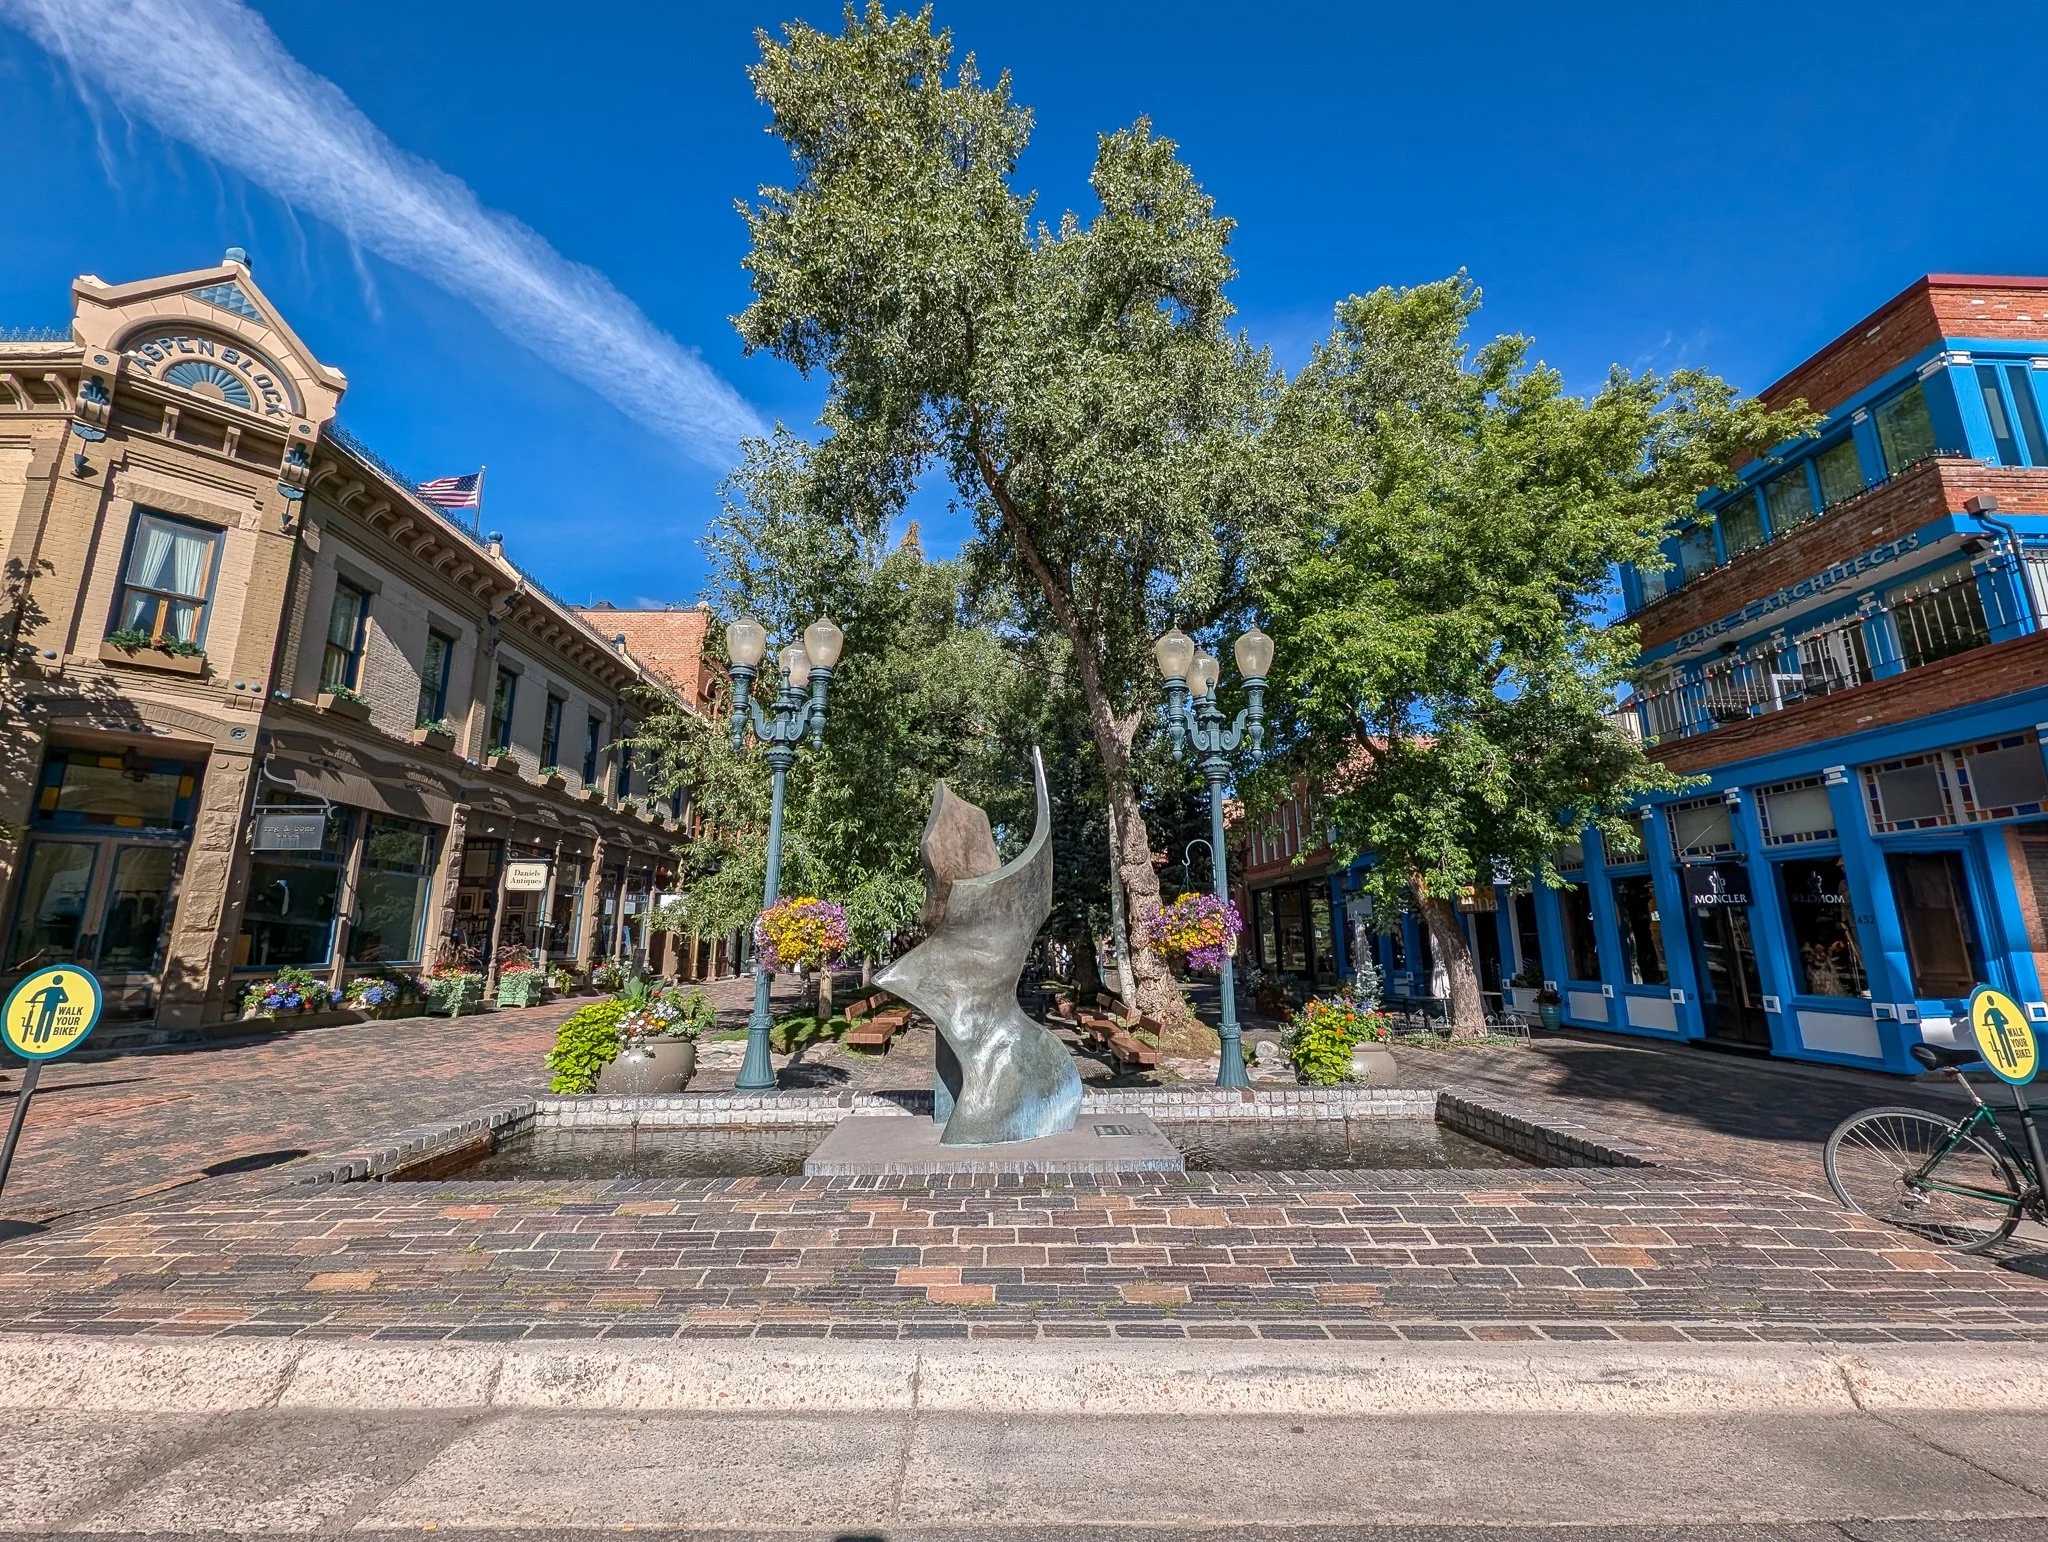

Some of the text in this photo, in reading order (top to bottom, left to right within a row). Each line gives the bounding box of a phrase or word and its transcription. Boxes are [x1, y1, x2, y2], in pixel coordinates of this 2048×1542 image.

[133, 336, 287, 418] ASPEN BLOCK
[1675, 533, 1920, 650] ZONE 4 ARCHITECTS
[514, 869, 541, 877] Daniels
[509, 877, 542, 886] Antiques
[1694, 893, 1748, 904] MONCLER
[58, 1006, 84, 1016] WALK
[56, 1016, 81, 1026] YOUR
[52, 1026, 78, 1036] BIKE!
[2006, 1027, 2025, 1037] WALK
[2010, 1038, 2029, 1048] YOUR
[2014, 1048, 2032, 1059] BIKE!
